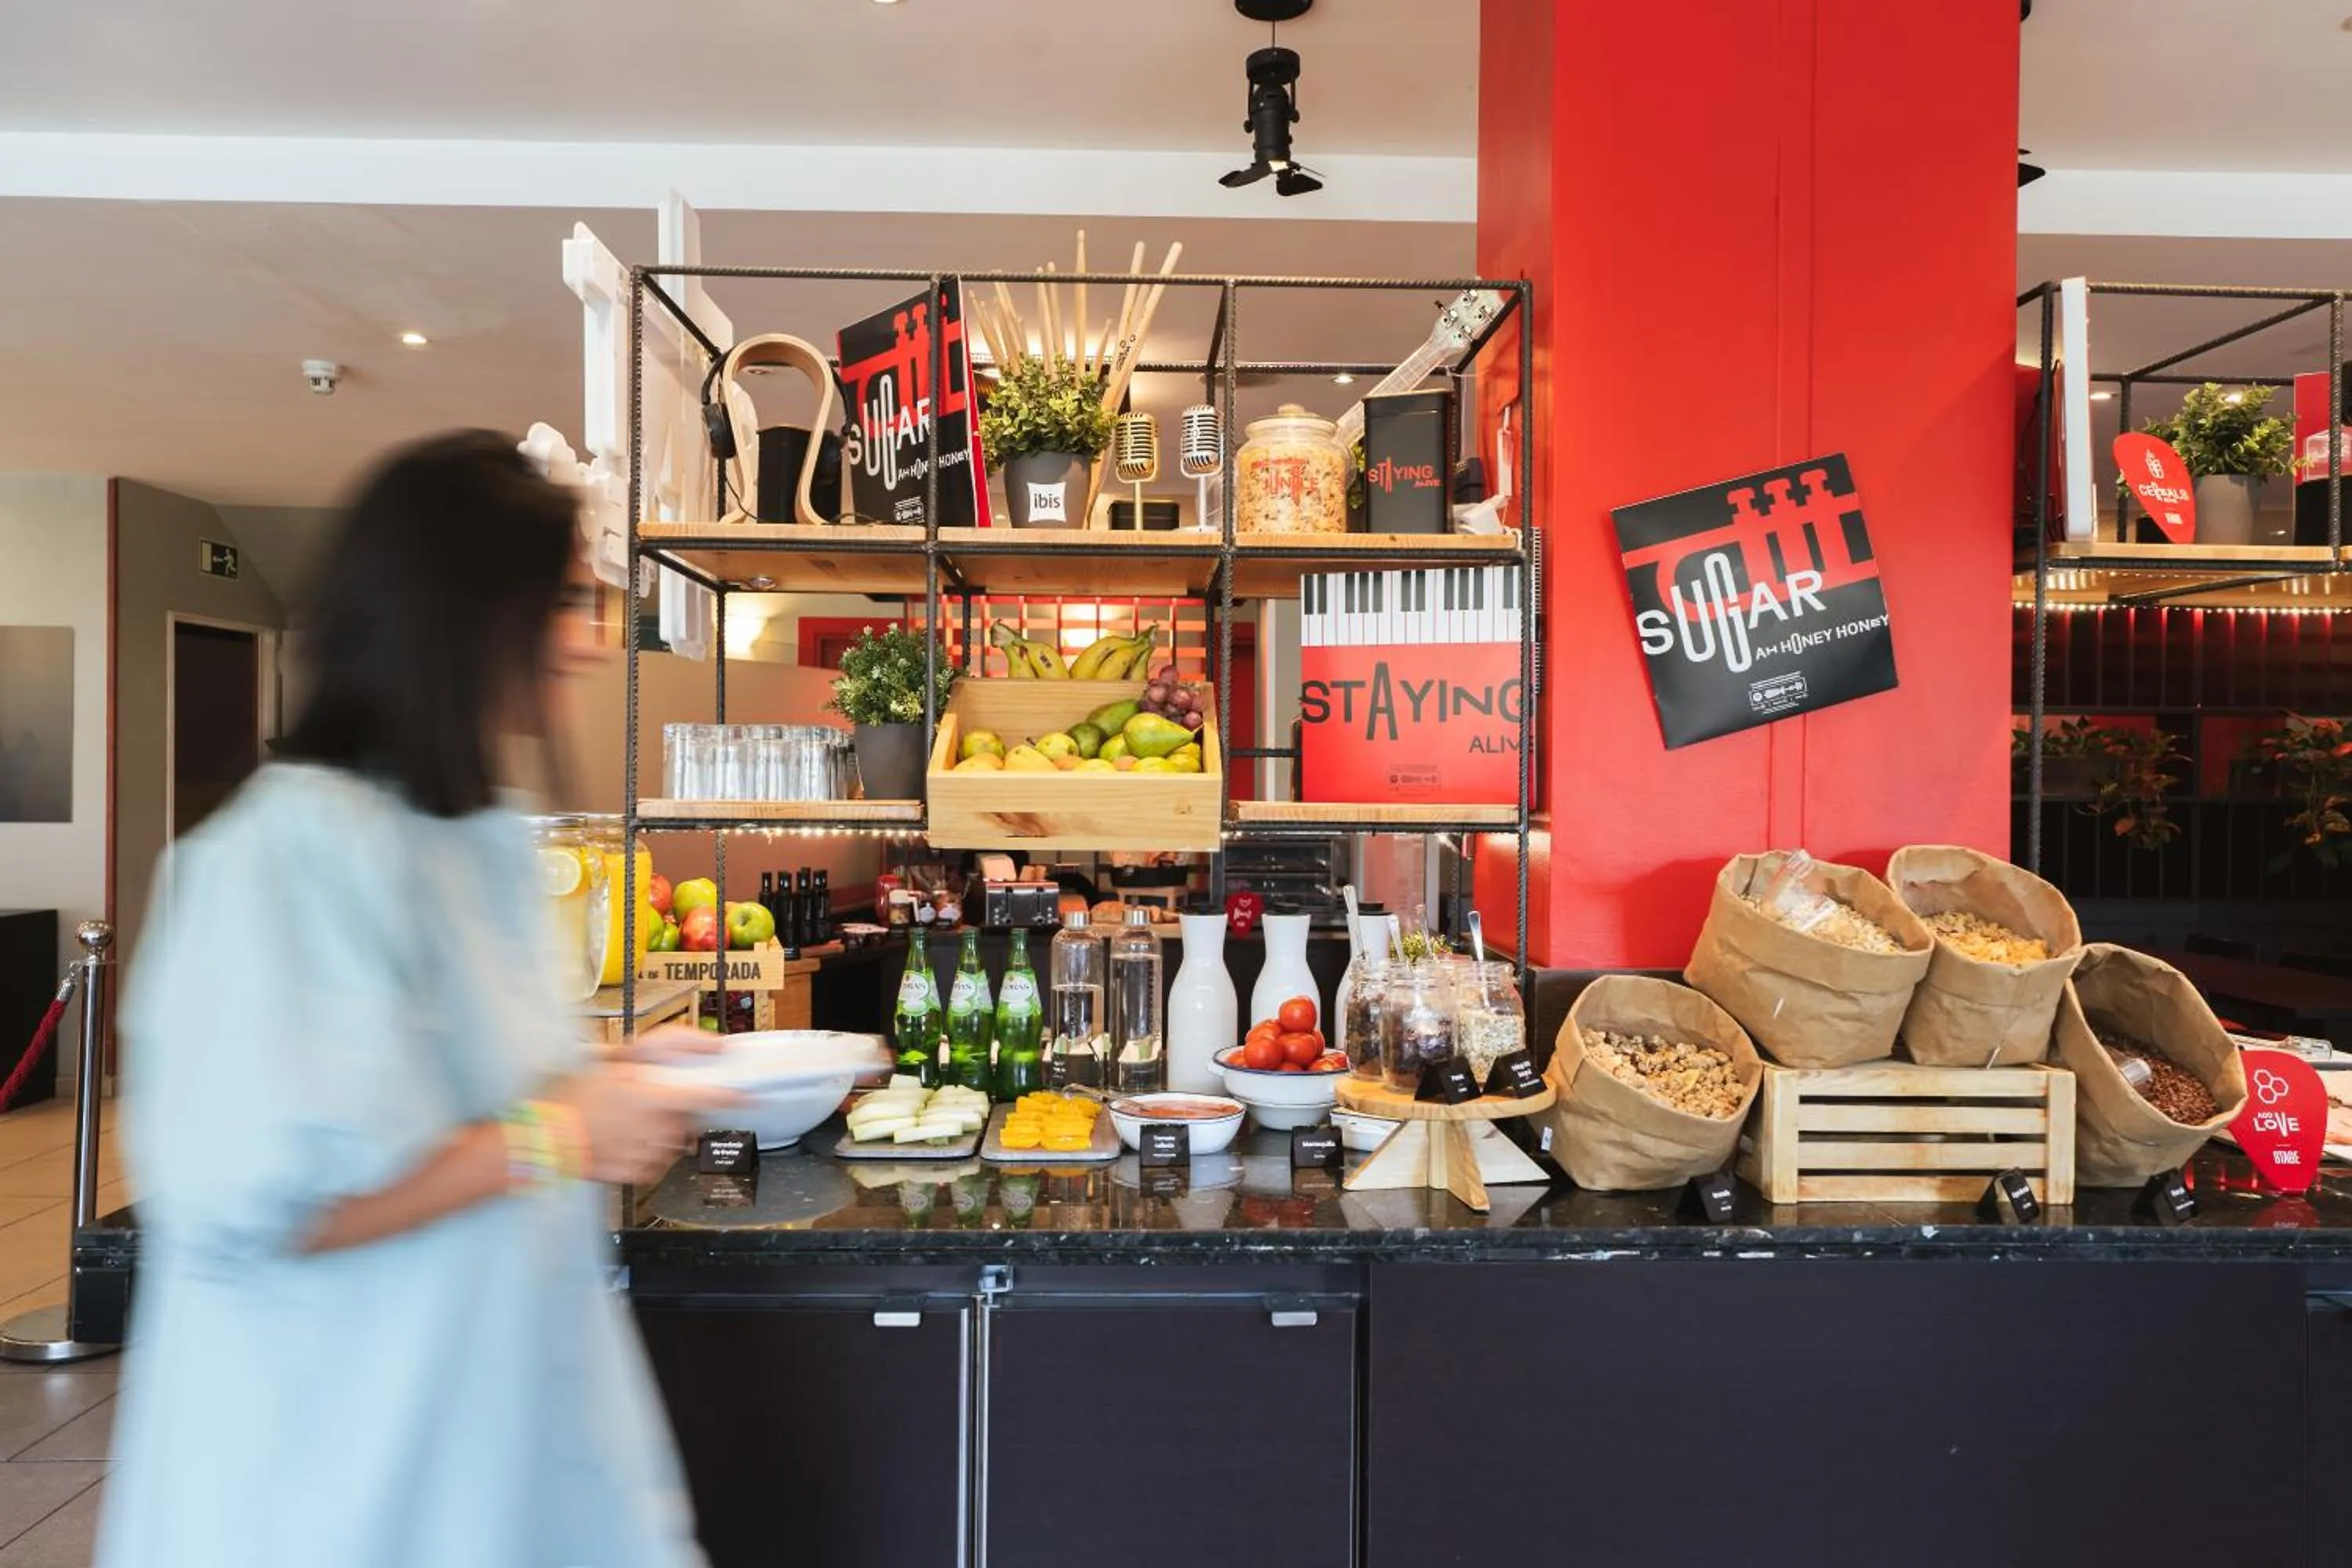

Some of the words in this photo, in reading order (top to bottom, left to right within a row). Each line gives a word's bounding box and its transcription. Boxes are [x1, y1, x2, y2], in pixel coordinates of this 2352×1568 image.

[848, 374, 931, 491] SUGAR
[938, 448, 971, 469] HONEY
[1367, 456, 1434, 495] STAYING
[1033, 492, 1062, 509] ibis
[1635, 551, 1828, 673] SUGAR
[1755, 644, 1778, 661] AH
[1780, 629, 1833, 655] HONEY
[1835, 613, 1890, 640] HONEY
[1301, 661, 1523, 741] STAYING
[1468, 735, 1523, 753] ALIV
[665, 961, 761, 981] TEMPORADA
[2252, 1111, 2301, 1138] LOVE
